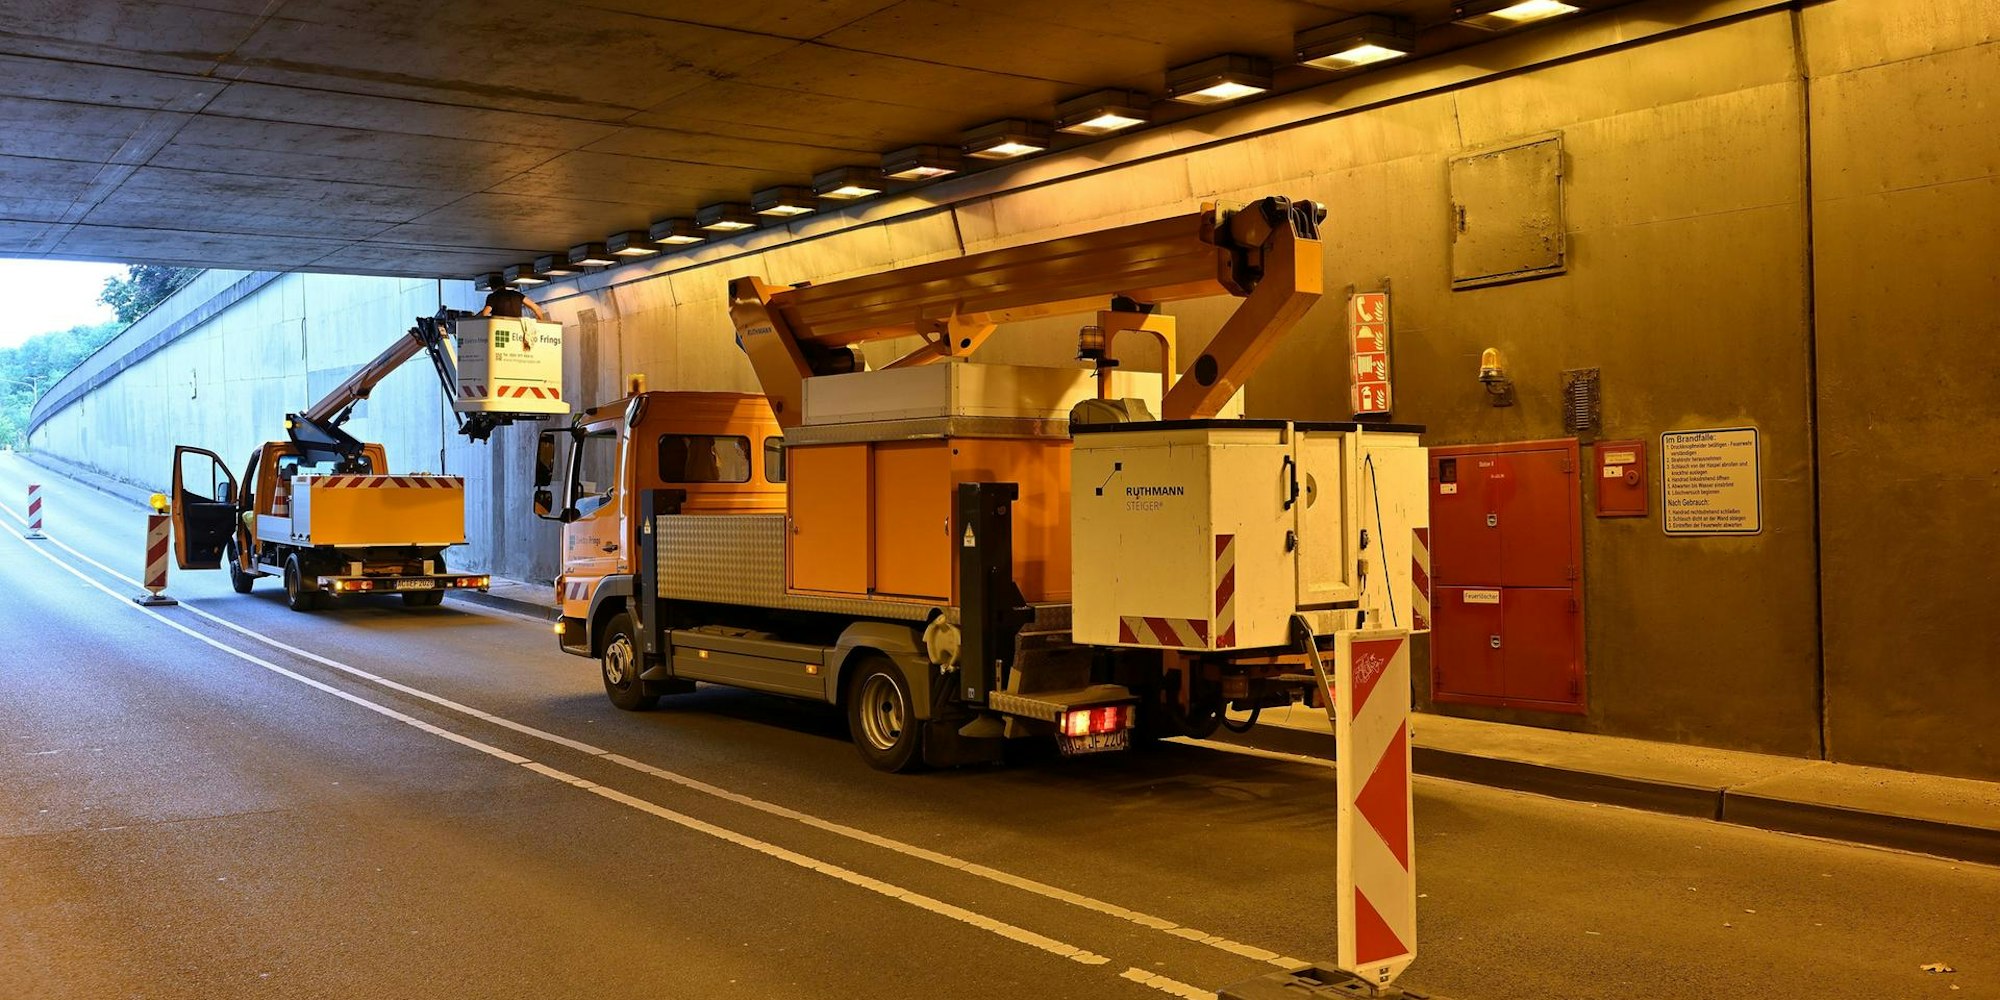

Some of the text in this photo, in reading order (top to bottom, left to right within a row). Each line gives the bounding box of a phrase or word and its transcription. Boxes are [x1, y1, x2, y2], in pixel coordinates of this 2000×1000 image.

[512, 332, 561, 346] Eleo Frings
[1666, 434, 1717, 444] Im Brandfalle:
[1126, 486, 1184, 497] RUTHMANN
[1668, 499, 1681, 507] Nach
